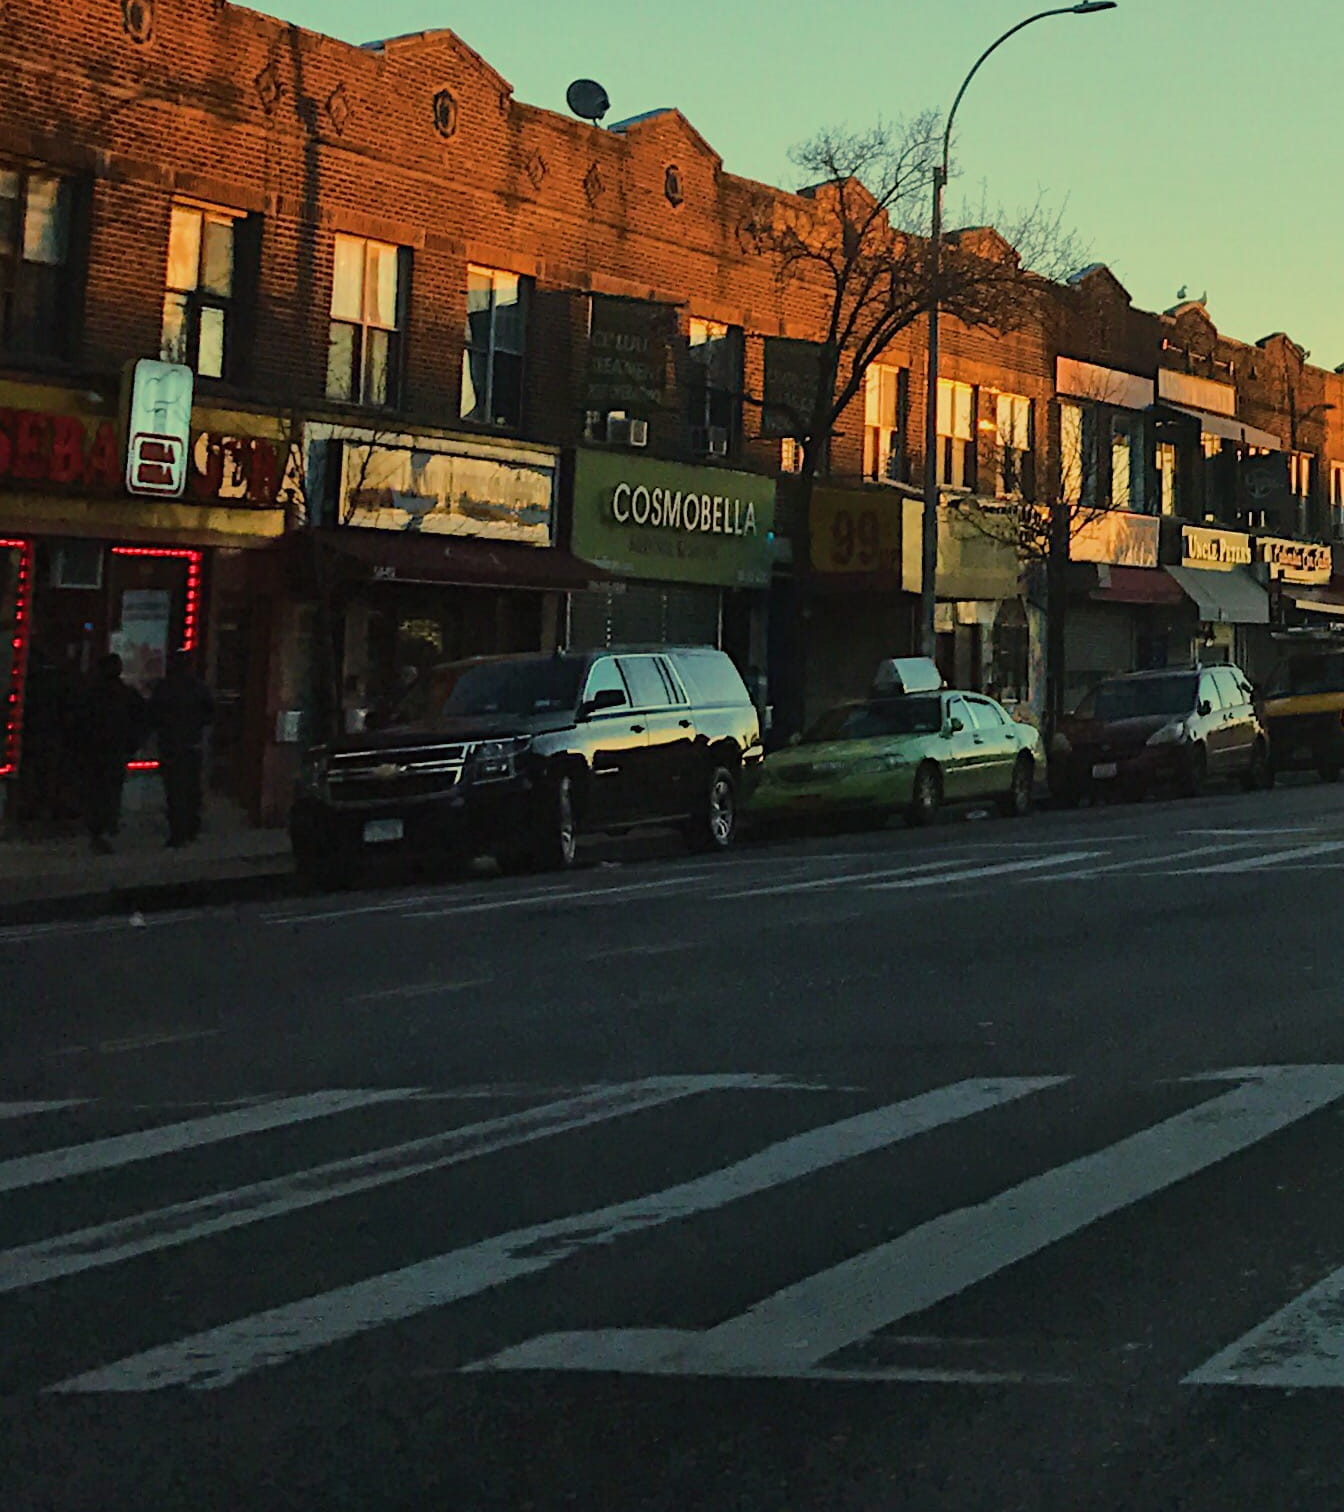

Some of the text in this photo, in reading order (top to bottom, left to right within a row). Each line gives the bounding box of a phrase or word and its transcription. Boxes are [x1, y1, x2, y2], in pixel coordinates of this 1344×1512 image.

[611, 481, 758, 537] COSMOBELLA
[833, 509, 879, 565] 99
[1188, 534, 1219, 561] UNCLE
